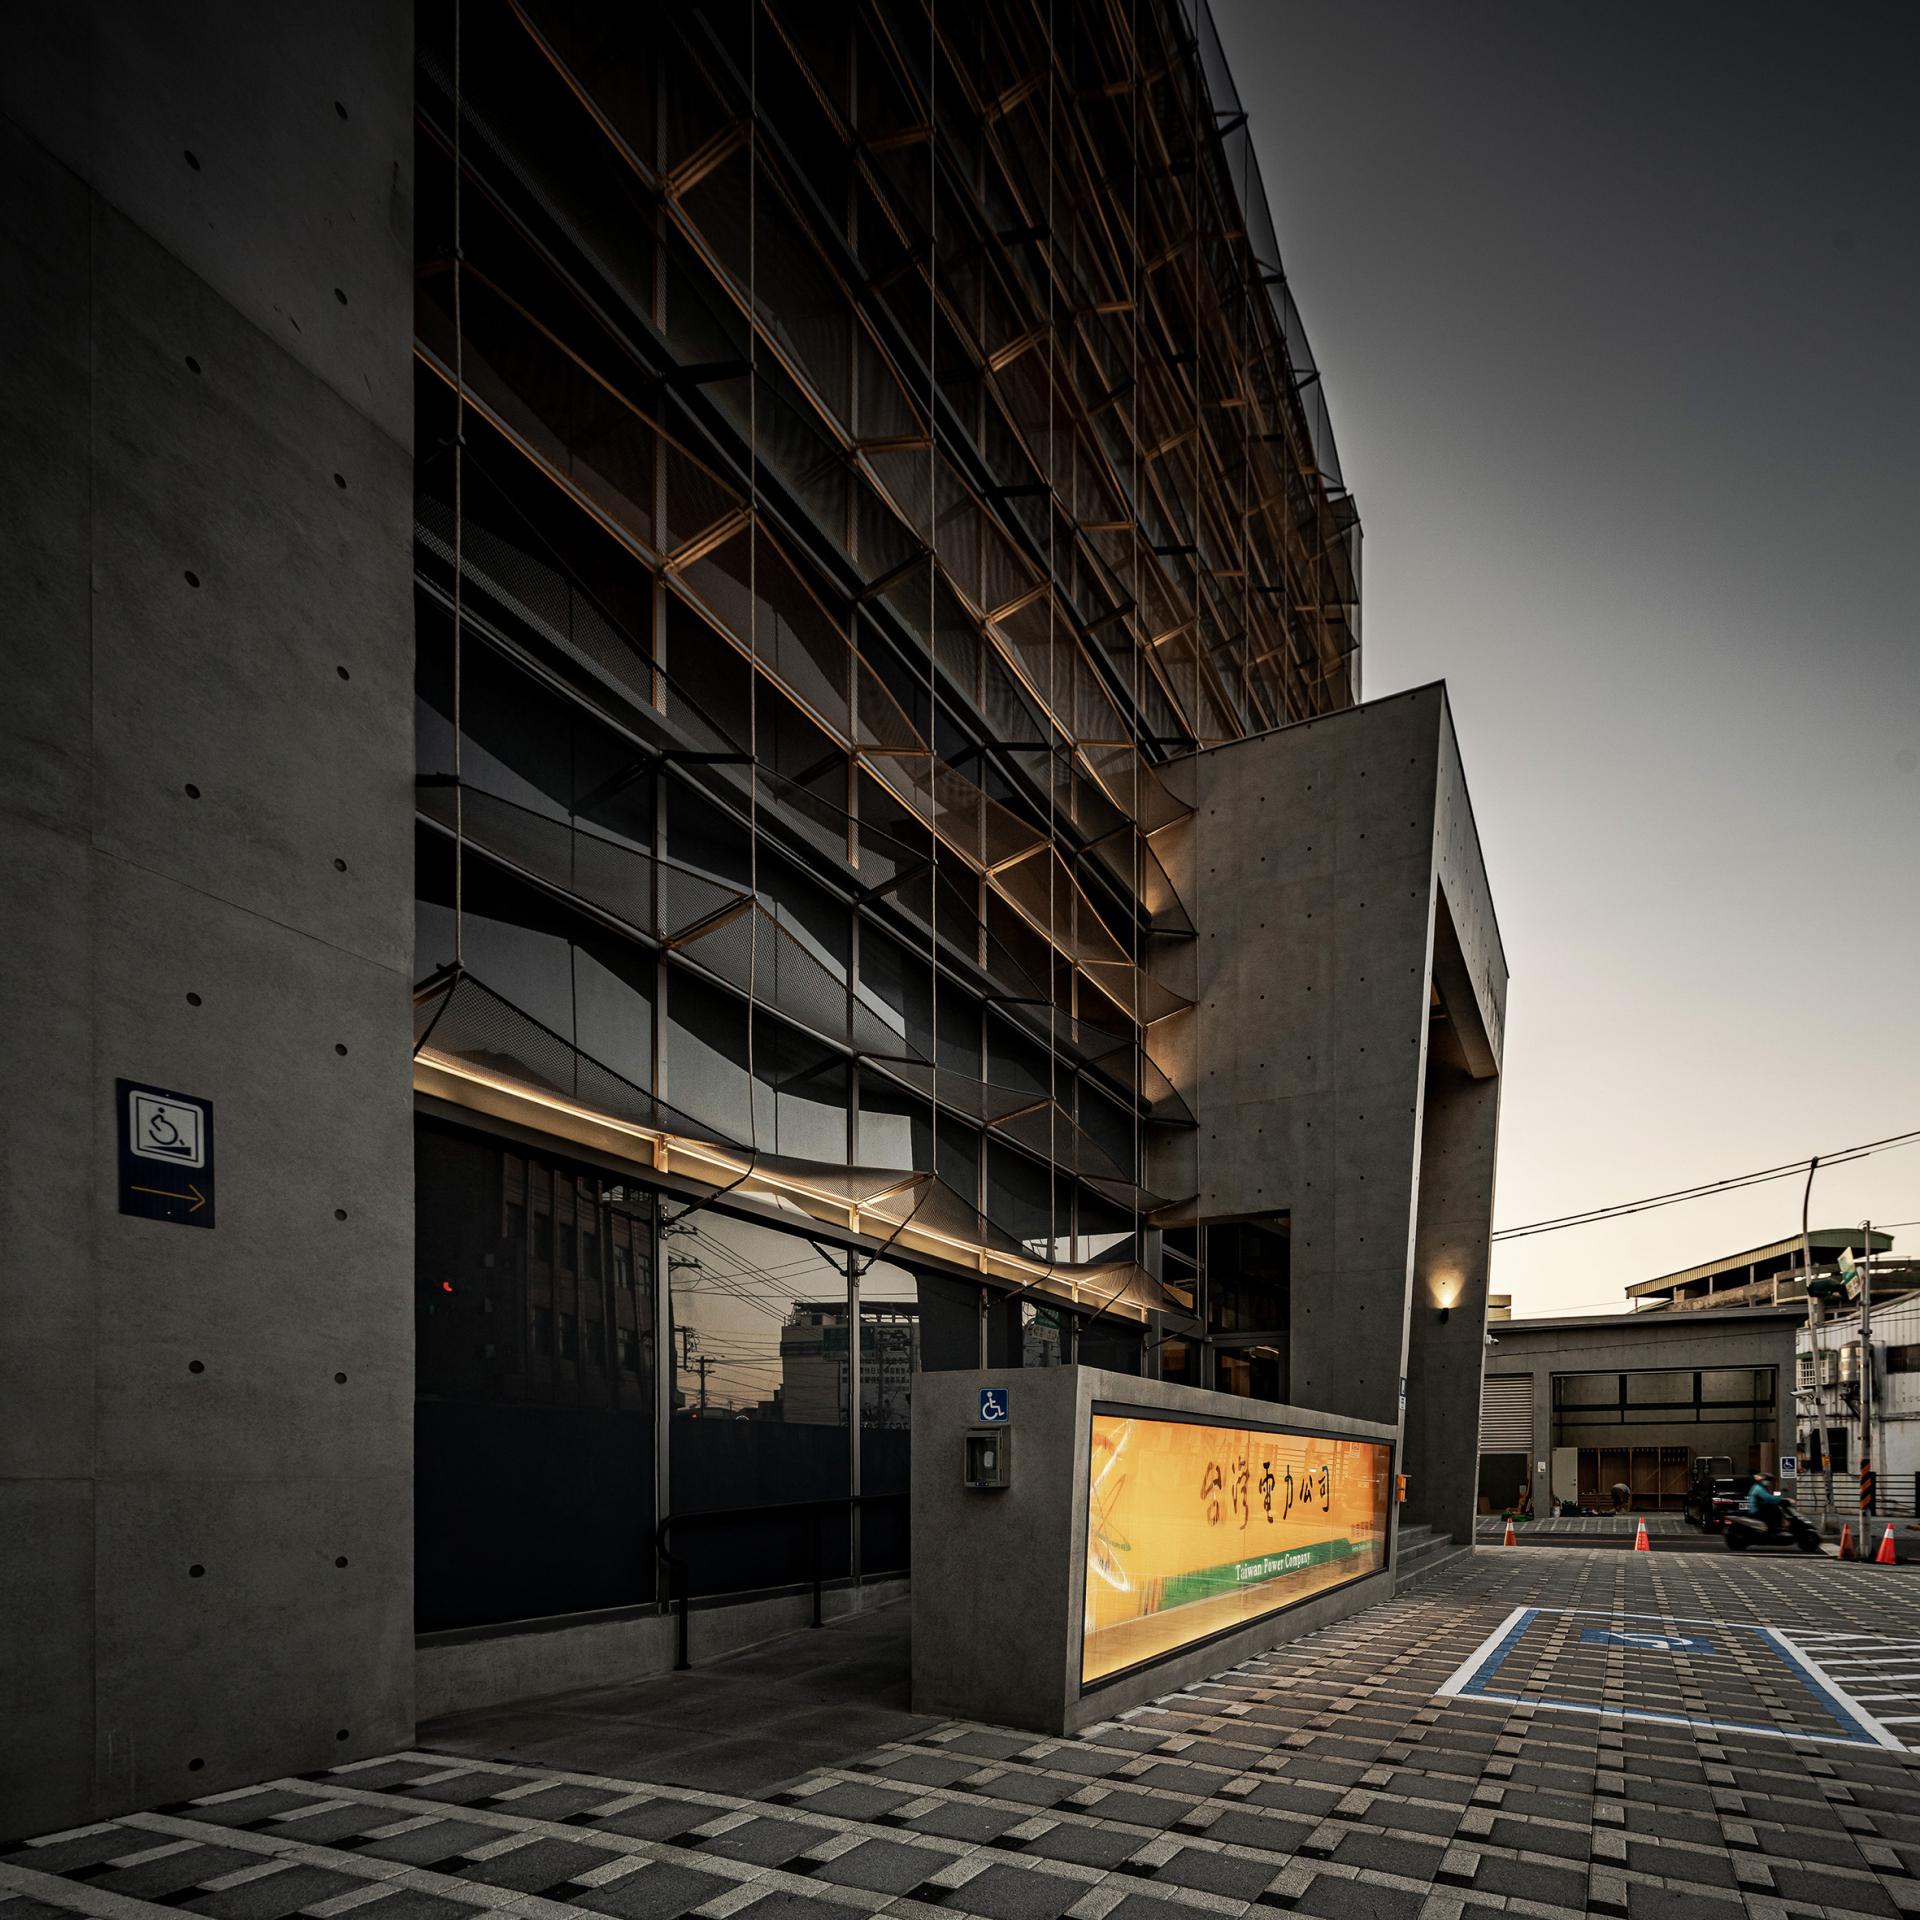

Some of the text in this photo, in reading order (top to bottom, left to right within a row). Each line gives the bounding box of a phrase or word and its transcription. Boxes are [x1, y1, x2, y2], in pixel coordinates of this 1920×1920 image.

[1200, 1456, 1330, 1530] 台灣電力公司
[1235, 1552, 1311, 1581] Taiwan Power Company
